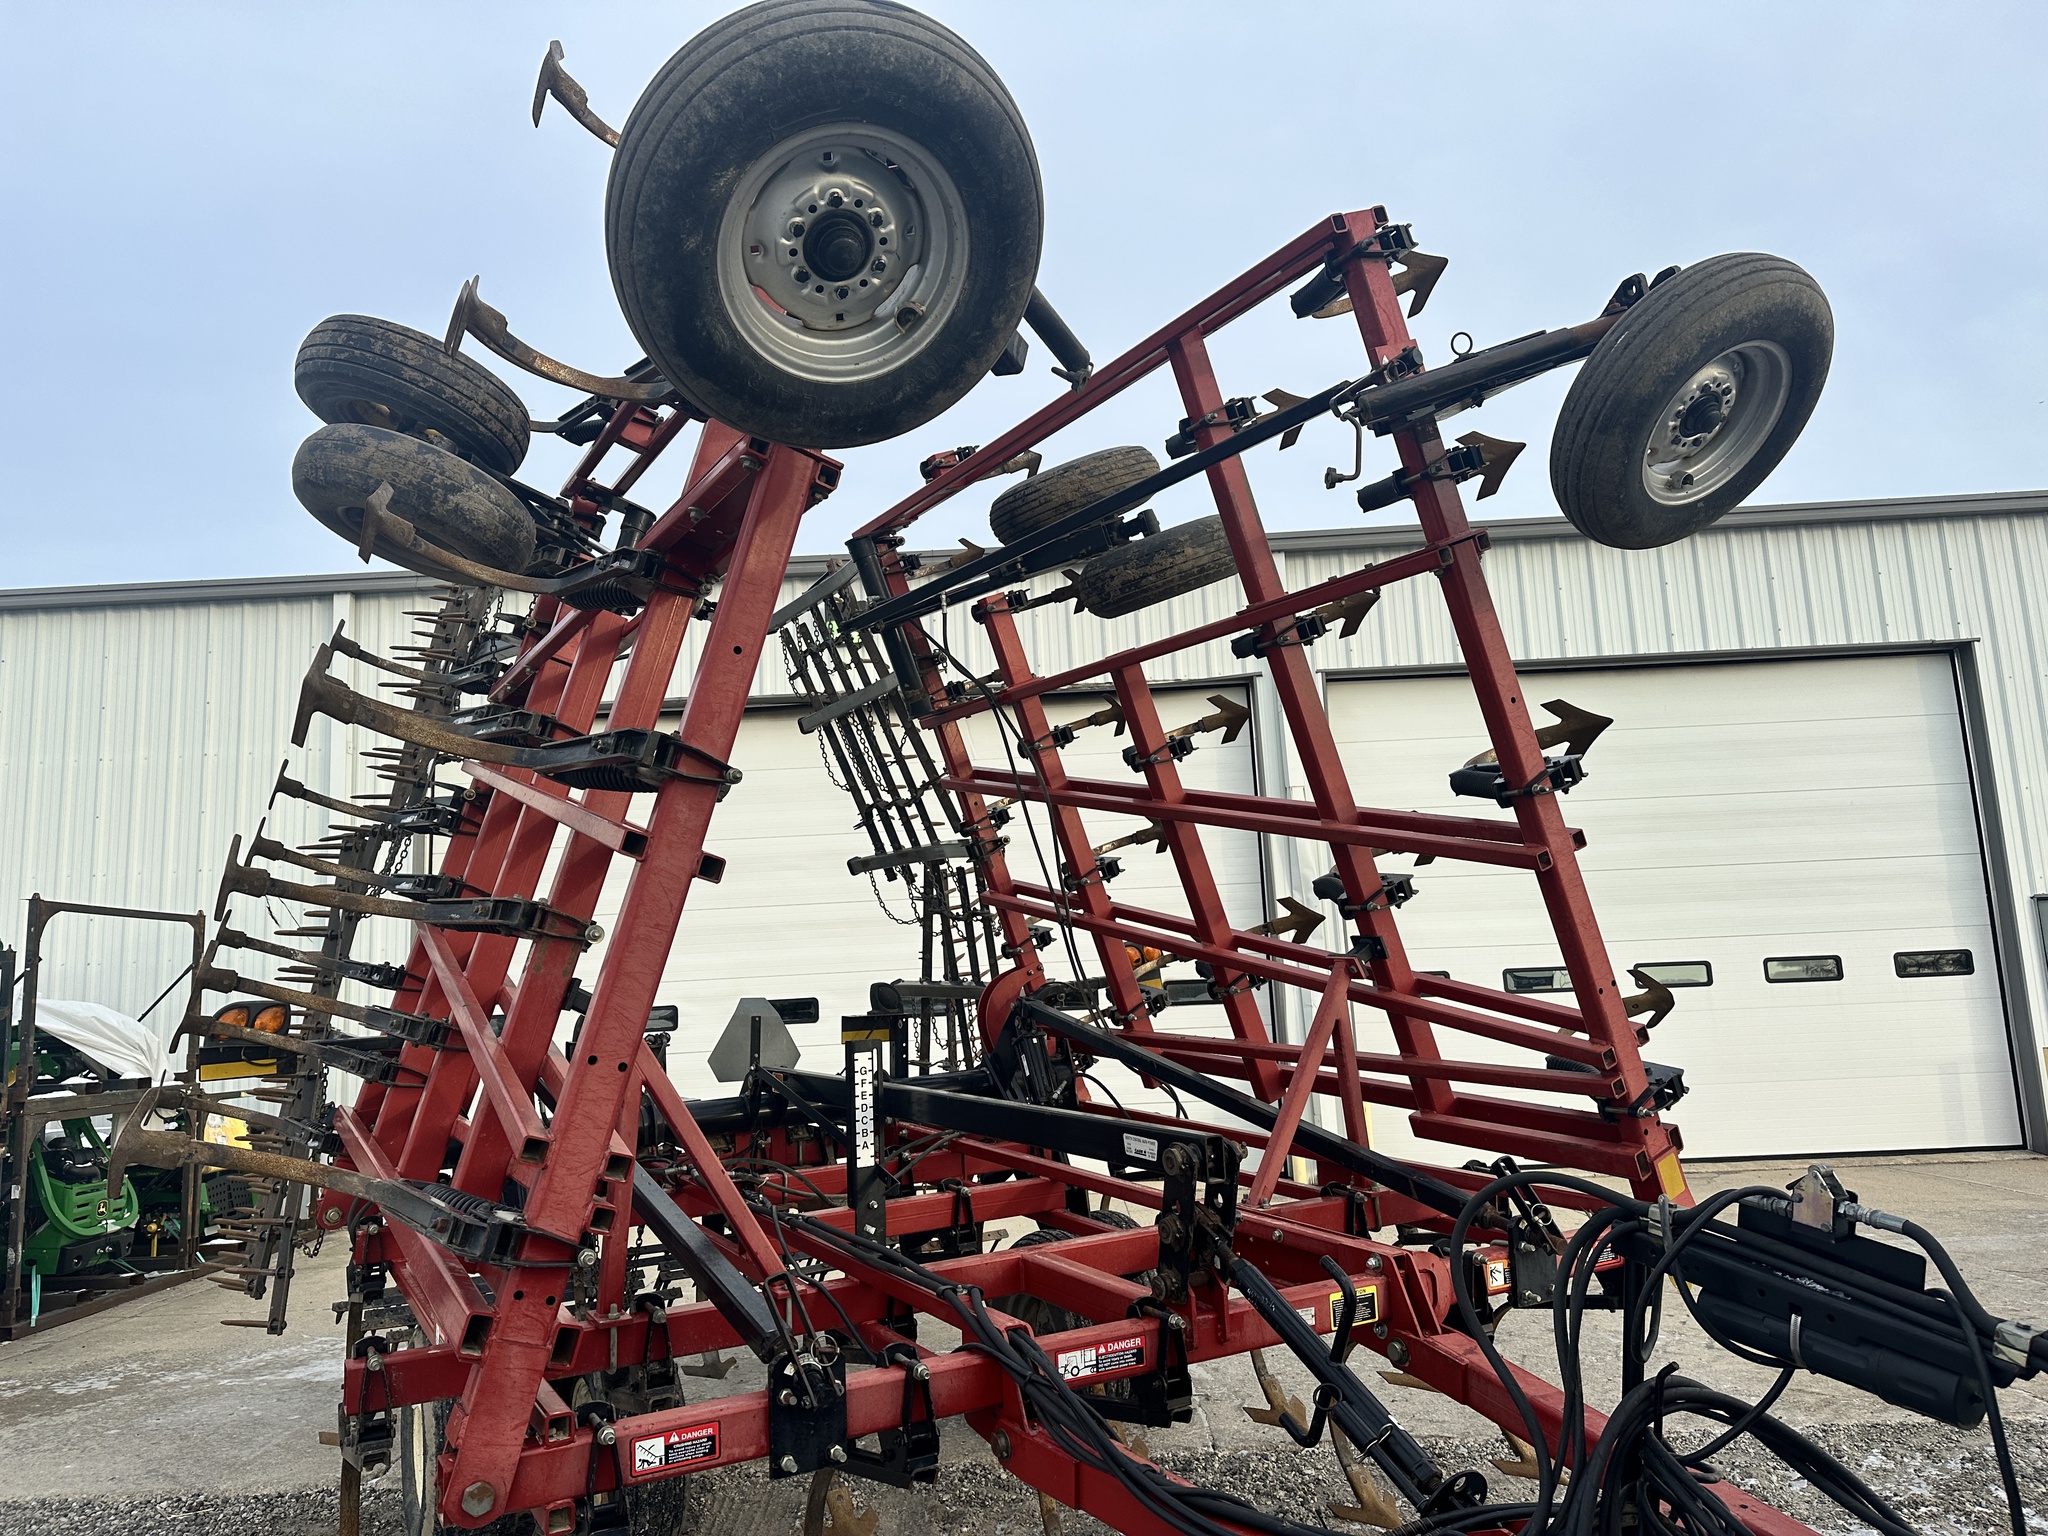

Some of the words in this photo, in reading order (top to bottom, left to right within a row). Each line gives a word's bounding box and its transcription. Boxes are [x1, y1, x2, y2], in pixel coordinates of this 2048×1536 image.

[860, 1066, 867, 1075] G
[861, 1079, 867, 1088] F
[861, 1091, 867, 1100] E
[861, 1103, 868, 1112] D
[861, 1116, 868, 1125] C
[862, 1128, 869, 1137] B
[862, 1141, 869, 1150] A
[1107, 1338, 1141, 1351] DANGER
[681, 1428, 713, 1440] DANGER
